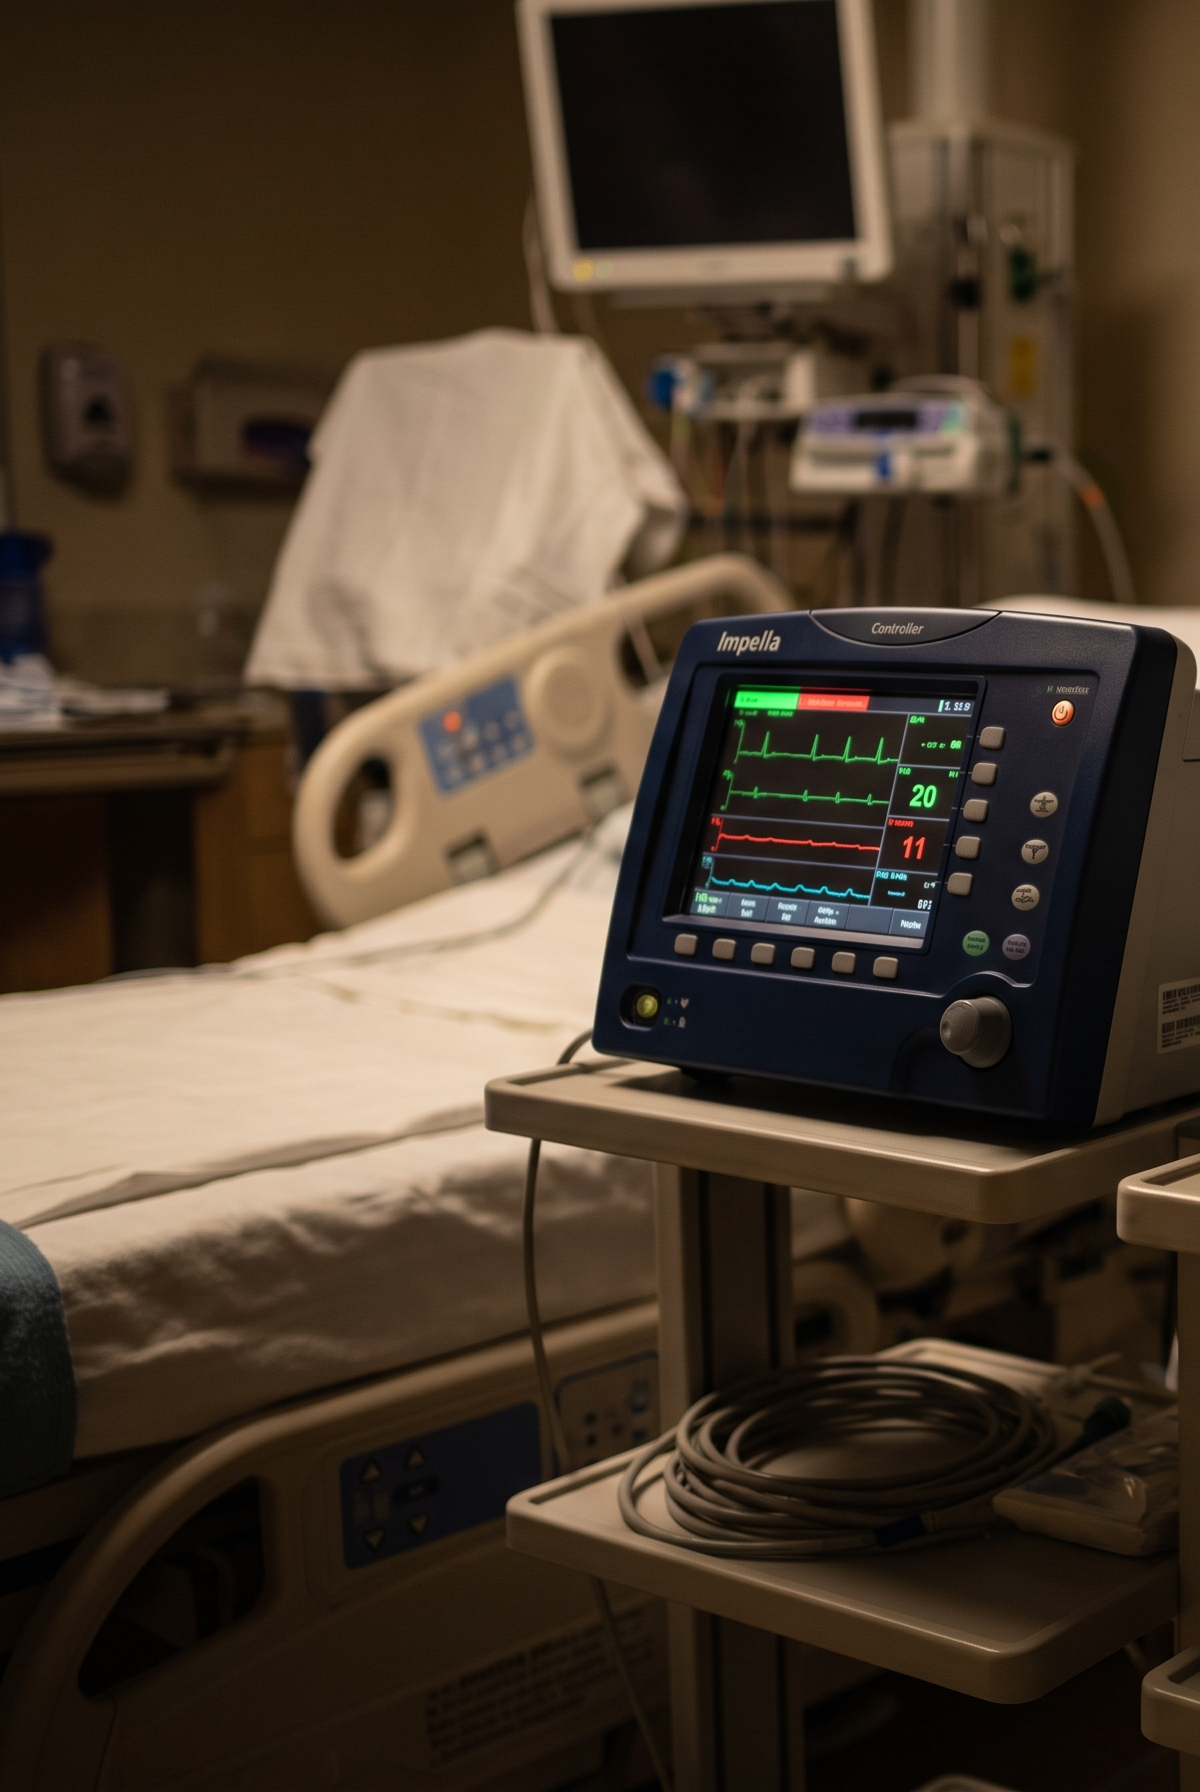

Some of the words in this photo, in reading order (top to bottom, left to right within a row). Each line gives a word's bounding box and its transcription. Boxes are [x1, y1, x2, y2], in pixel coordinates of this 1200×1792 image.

[871, 622, 925, 635] Controller
[717, 630, 782, 656] Impella
[908, 784, 938, 809] 20
[902, 836, 926, 860] 11
